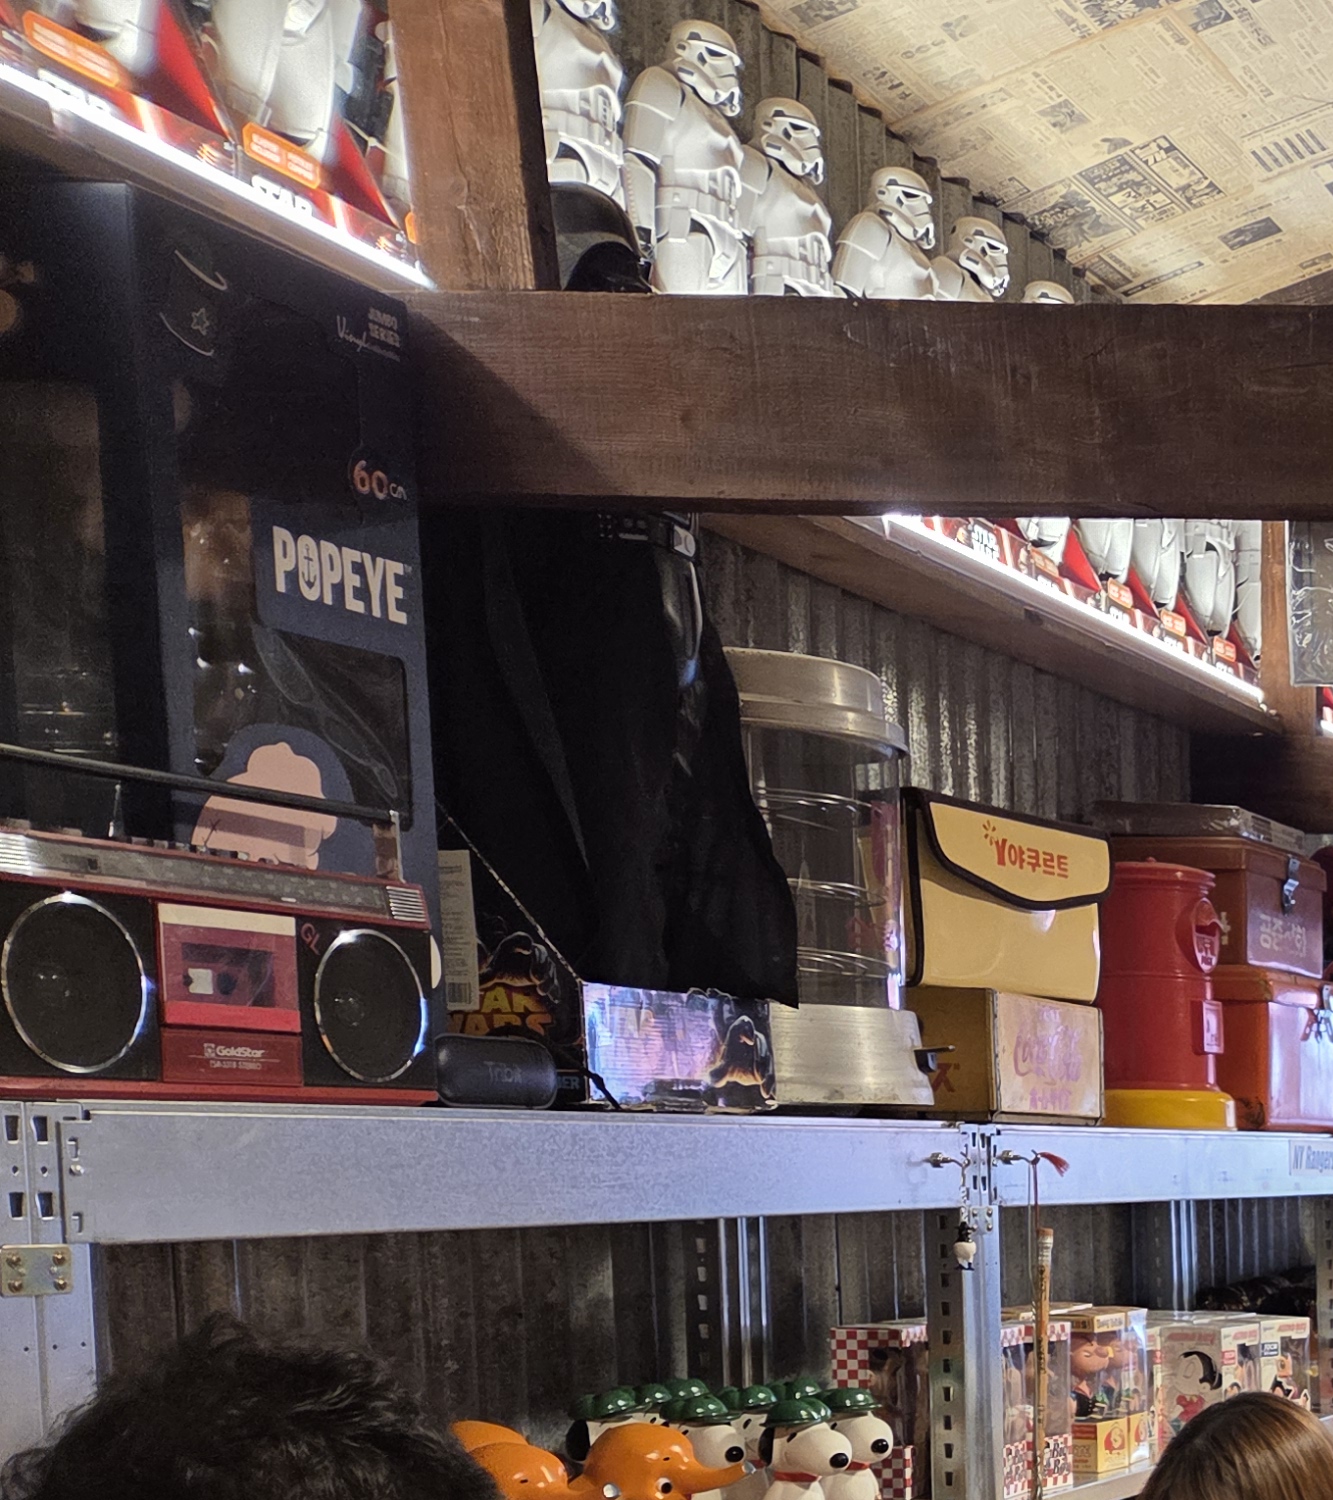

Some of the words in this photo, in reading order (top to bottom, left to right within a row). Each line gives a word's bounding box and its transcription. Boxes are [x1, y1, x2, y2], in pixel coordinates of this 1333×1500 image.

[272, 525, 408, 625] POPEYE
[1008, 843, 1069, 879] 야쿠르트
[216, 1044, 266, 1058] GoldStar
